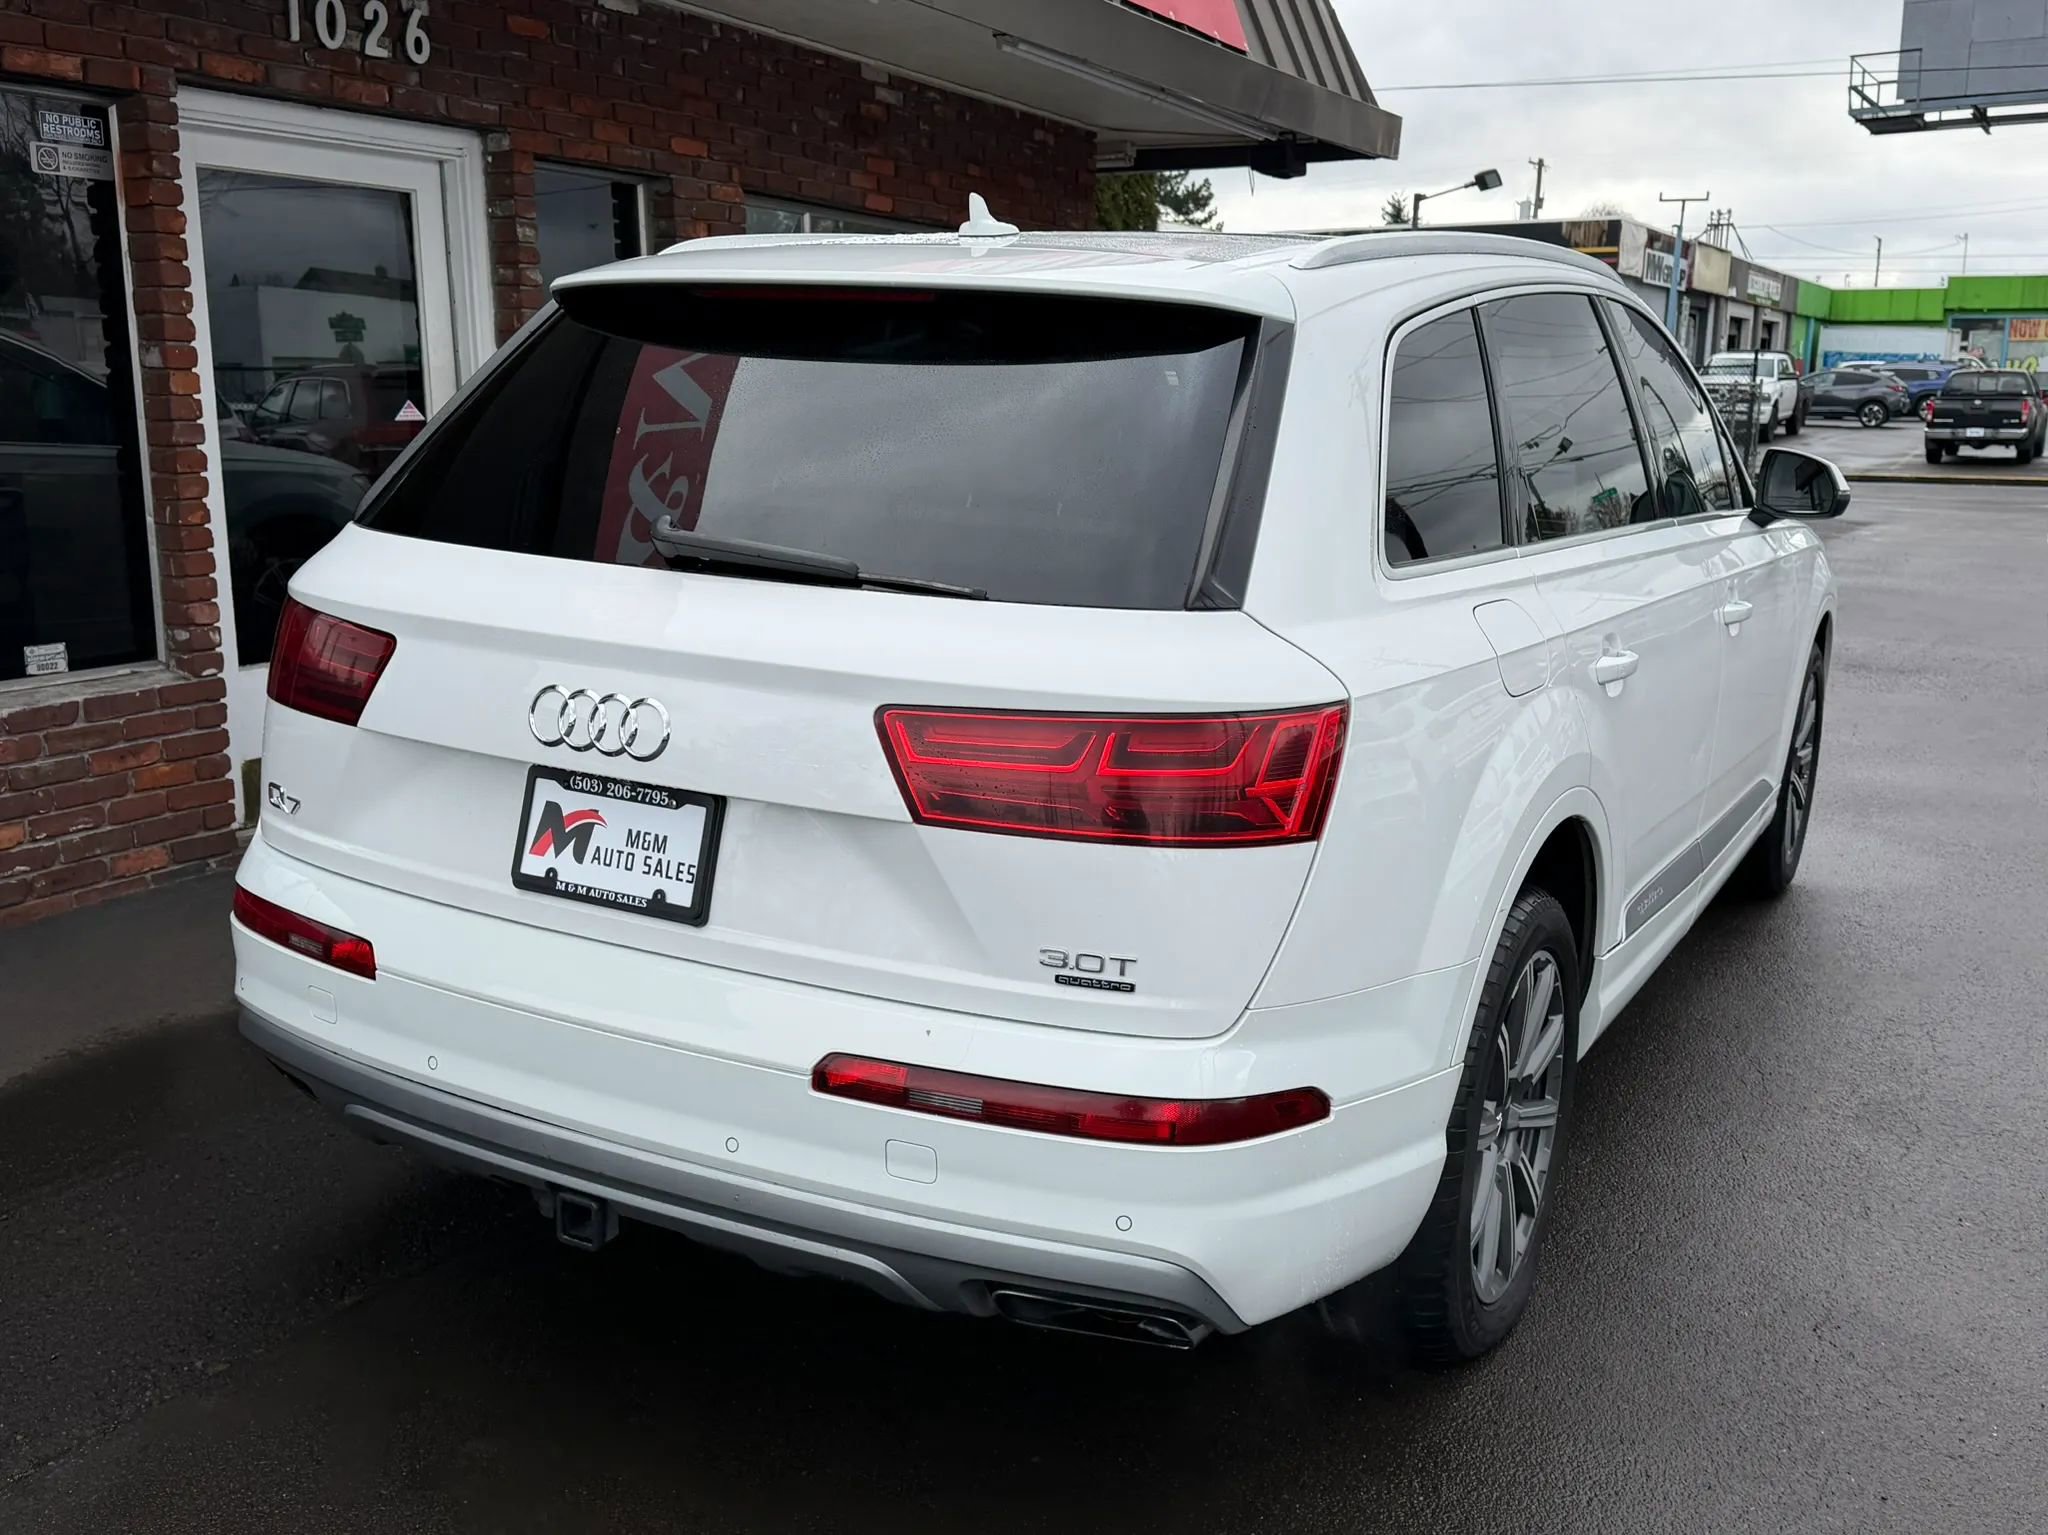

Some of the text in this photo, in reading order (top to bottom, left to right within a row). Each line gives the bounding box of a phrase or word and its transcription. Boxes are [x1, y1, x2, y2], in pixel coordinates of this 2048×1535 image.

[288, 0, 431, 65] 1026
[42, 123, 101, 140] RESTROOMS
[45, 113, 97, 130] NO PUBLIC
[61, 151, 73, 160] NO
[2010, 319, 2042, 338] NOW
[268, 781, 301, 815] Q7
[569, 775, 669, 807] (503) 206-7795
[625, 828, 668, 855] M&M
[590, 846, 697, 885] AUTO SALES
[588, 887, 616, 903] AUTO
[616, 894, 648, 908] SALES
[1058, 976, 1132, 992] quattro
